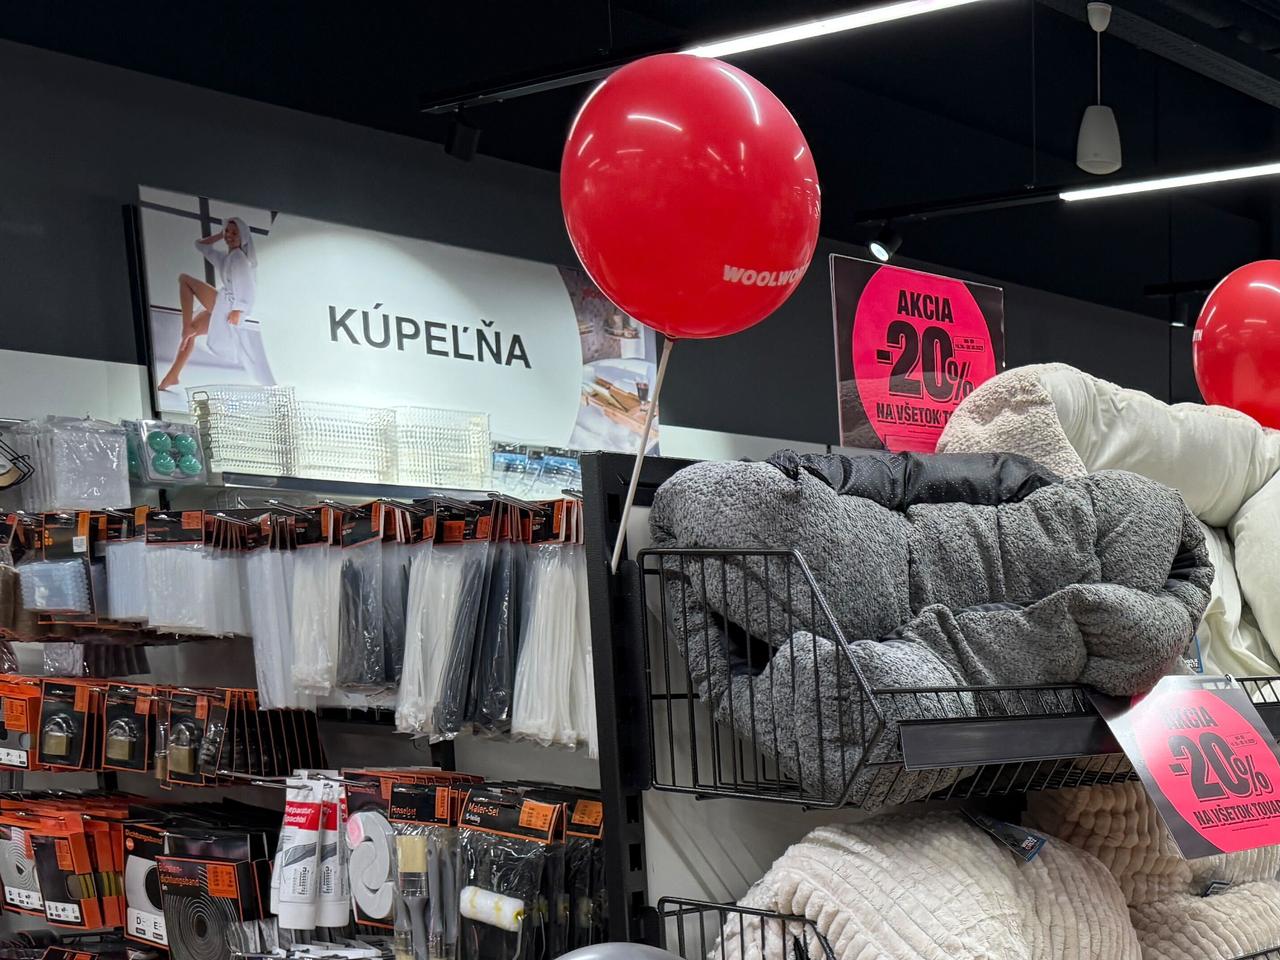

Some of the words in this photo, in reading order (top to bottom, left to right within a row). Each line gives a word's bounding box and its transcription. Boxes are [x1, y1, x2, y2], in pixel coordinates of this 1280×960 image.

[897, 289, 954, 324] AKCIA
[329, 303, 532, 369] KÚPEĽŇA
[876, 320, 975, 404] -20%
[876, 402, 894, 421] NA
[896, 402, 941, 425] VŠETOK
[1168, 732, 1273, 802] -20%
[1193, 809, 1215, 826] NA
[1214, 803, 1252, 823] VŠETOK
